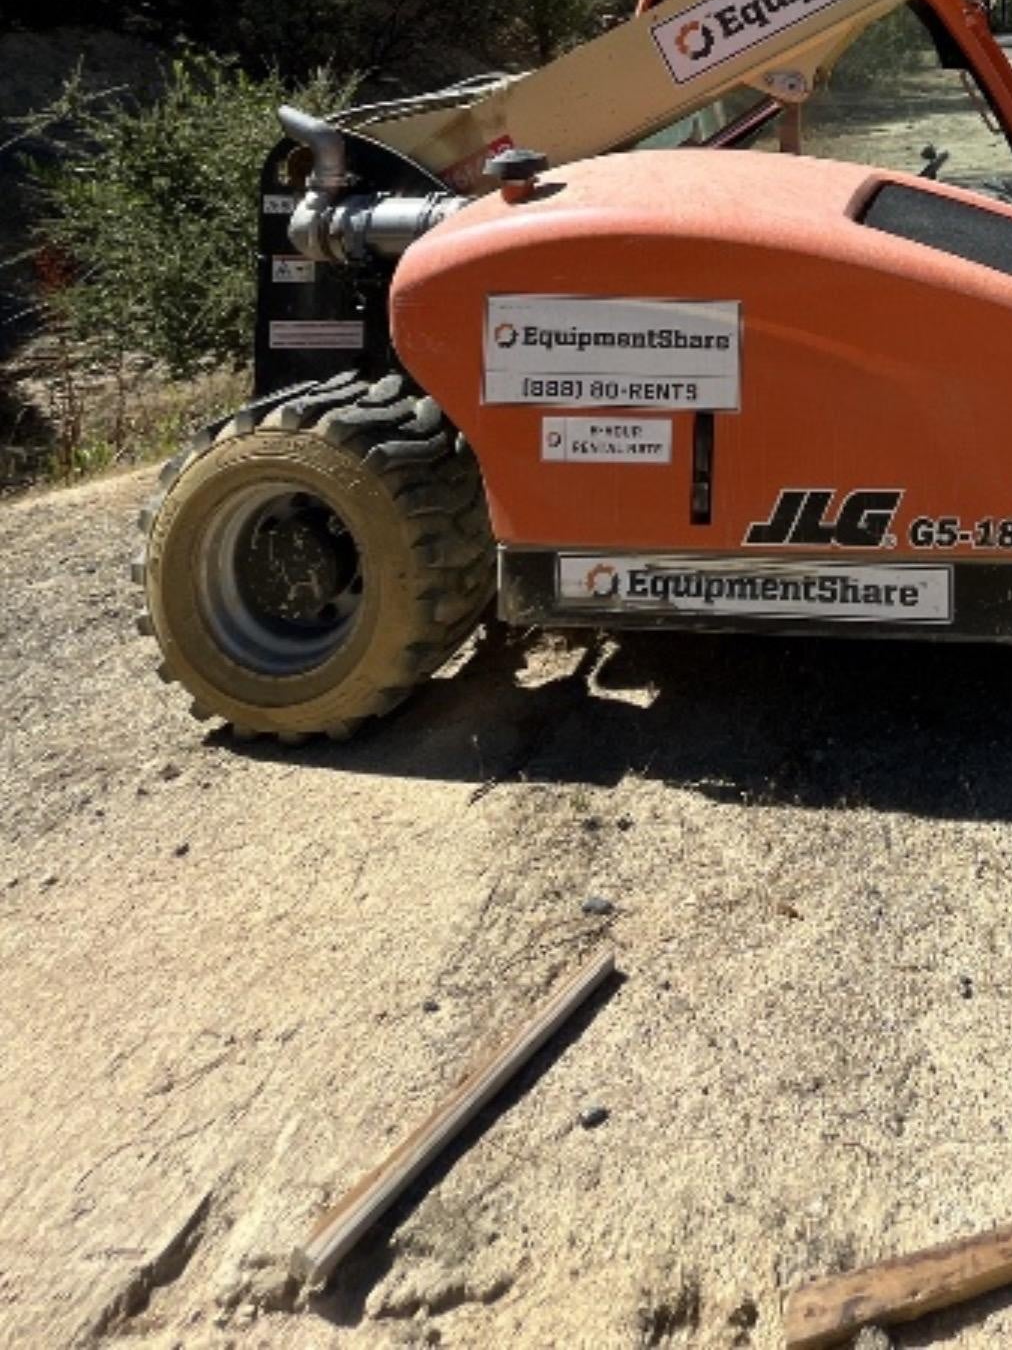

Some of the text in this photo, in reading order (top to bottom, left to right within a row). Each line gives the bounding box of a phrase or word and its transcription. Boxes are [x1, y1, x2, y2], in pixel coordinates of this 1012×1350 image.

[522, 326, 731, 351] EquipmentShare
[741, 488, 907, 549] JLG
[626, 568, 920, 606] EquipmentShare
